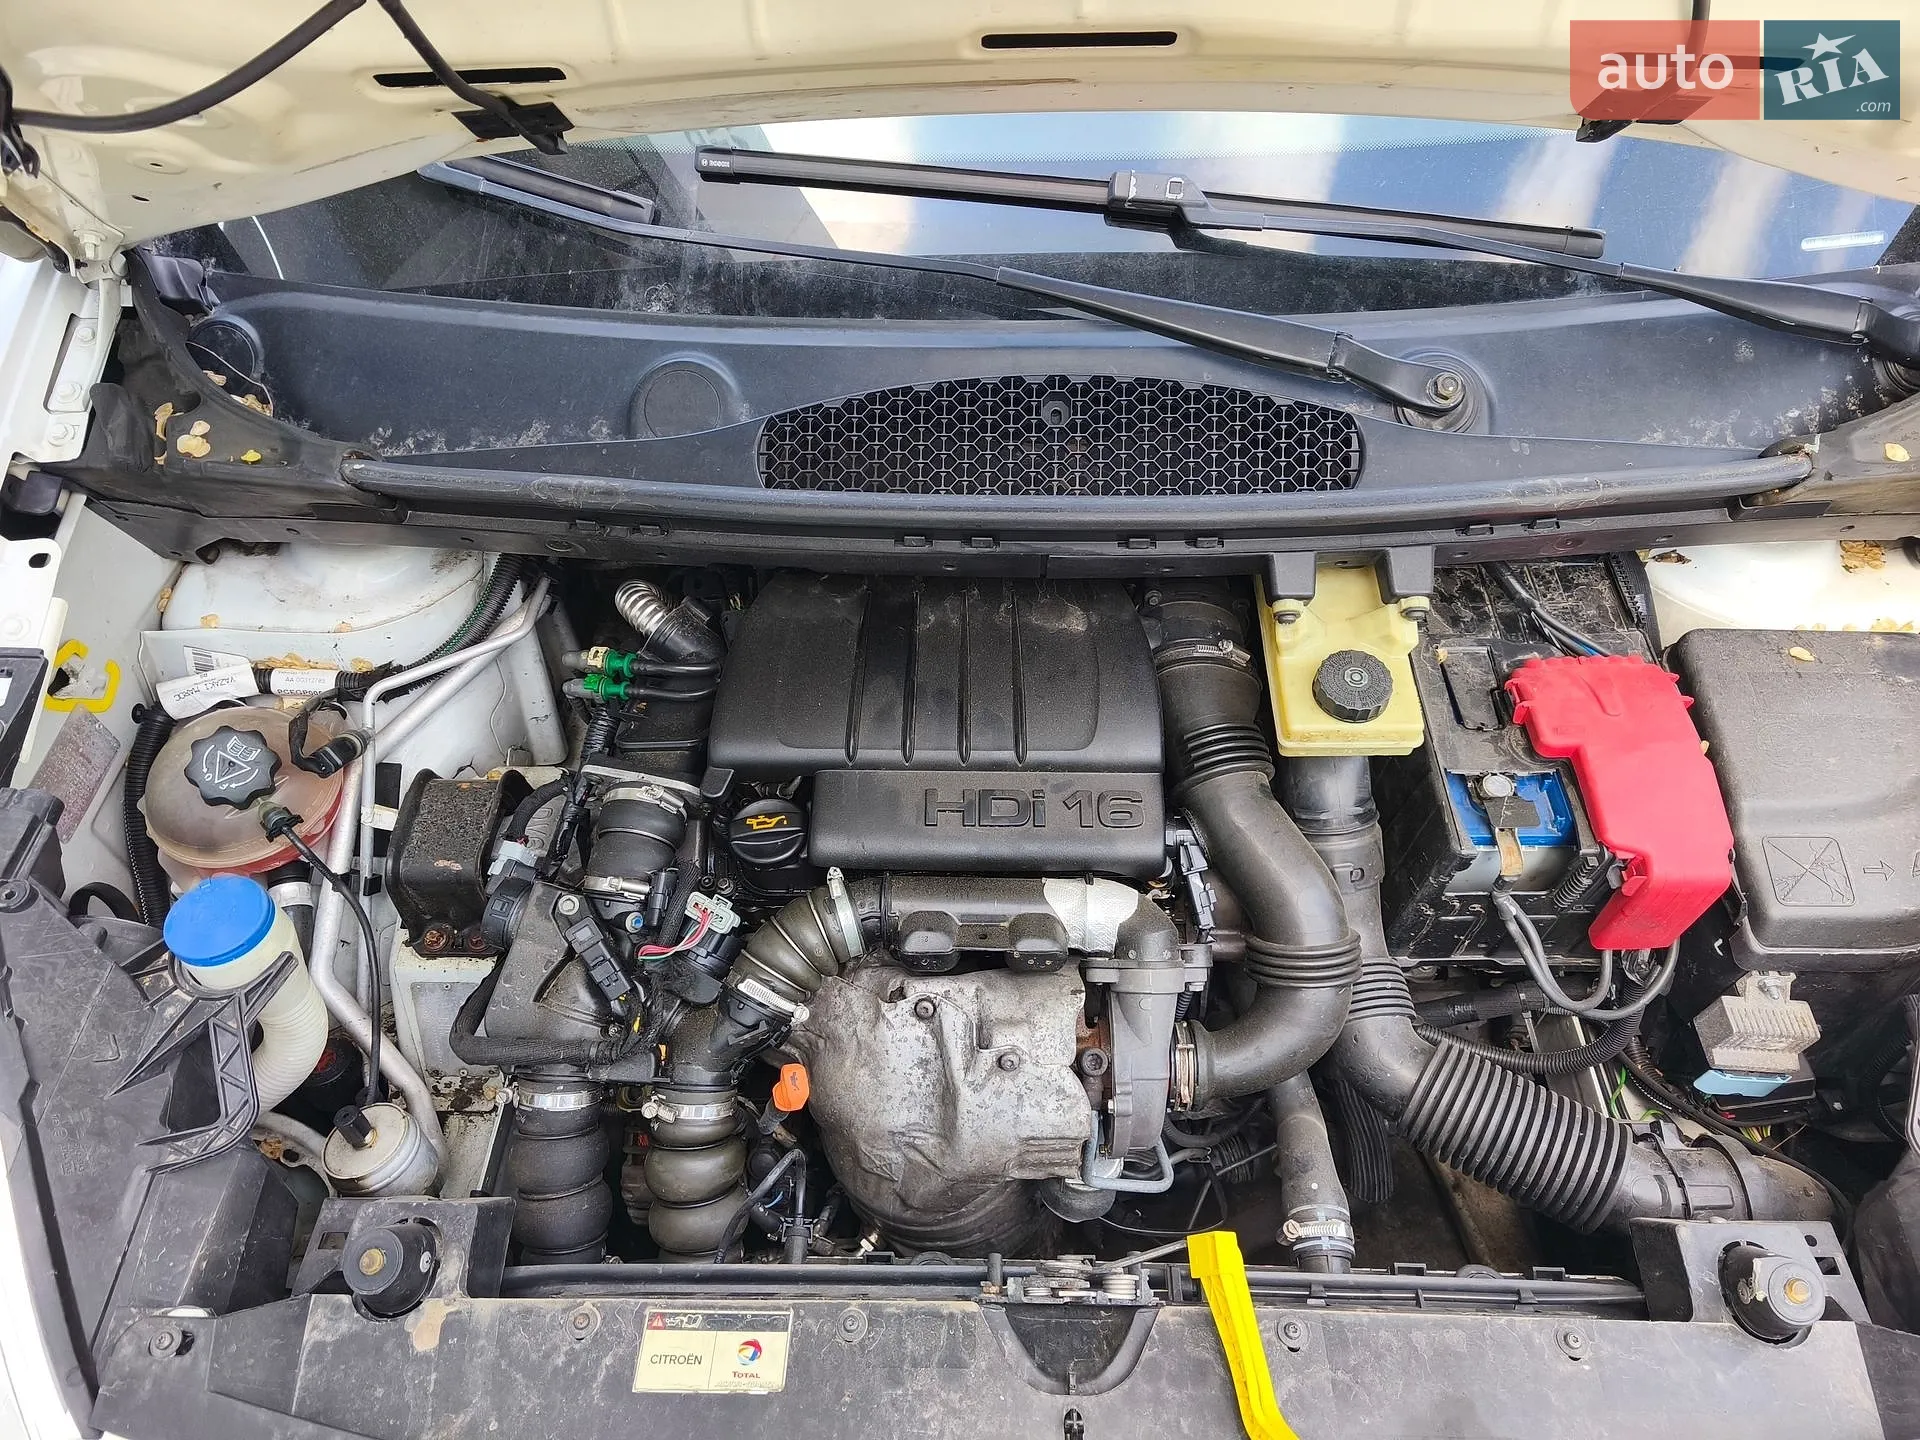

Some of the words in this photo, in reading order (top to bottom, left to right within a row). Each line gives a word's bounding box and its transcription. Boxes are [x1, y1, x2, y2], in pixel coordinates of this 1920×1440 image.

[924, 787, 1046, 828] HDi
[1062, 789, 1145, 829] 16
[650, 1352, 703, 1366] CITROËN
[732, 1370, 761, 1379] TOTAL
